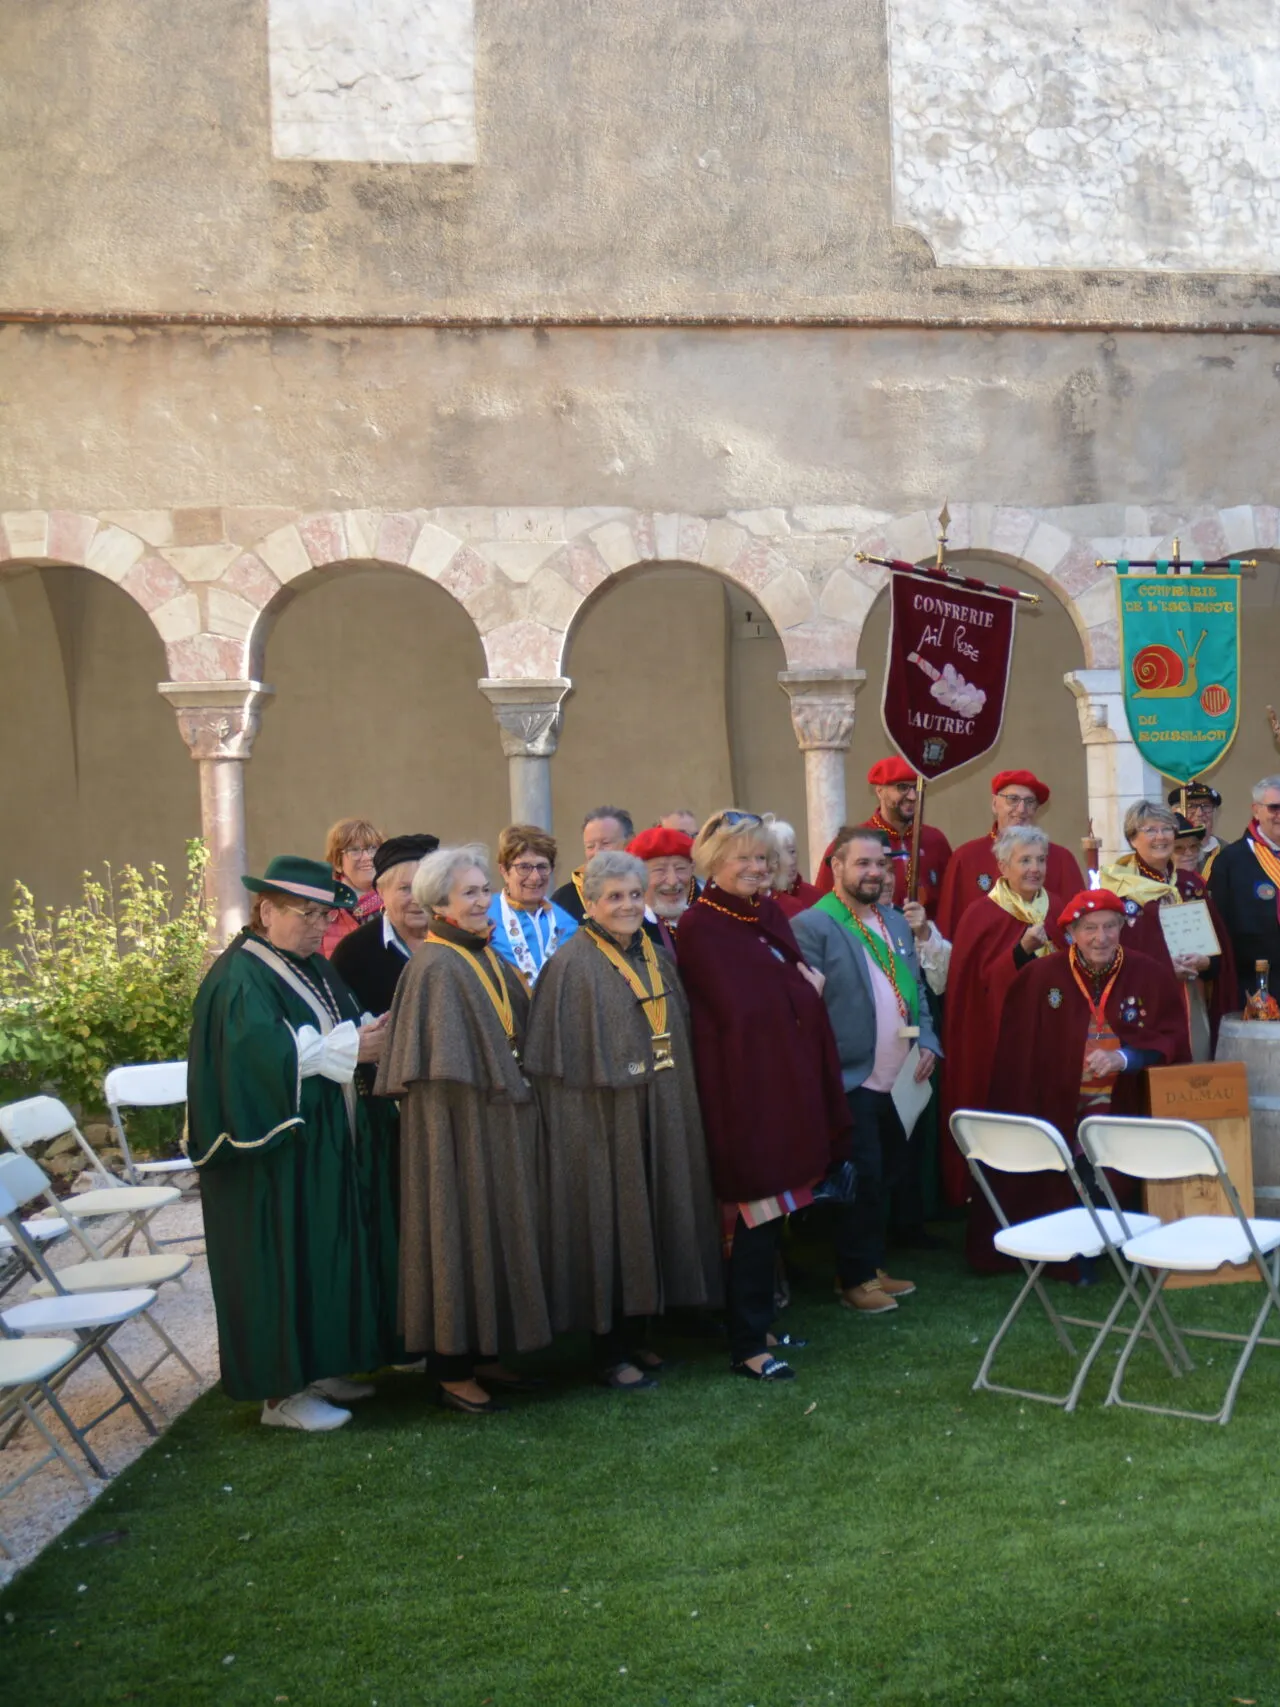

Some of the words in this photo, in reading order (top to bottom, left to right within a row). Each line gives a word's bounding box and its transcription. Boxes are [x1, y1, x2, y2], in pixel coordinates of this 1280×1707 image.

[913, 594, 995, 628] CONFRERIE
[917, 618, 946, 652] Ail
[907, 709, 975, 736] LAUTREC
[1138, 714, 1157, 726] DU
[1165, 1087, 1234, 1104] DALMAU
